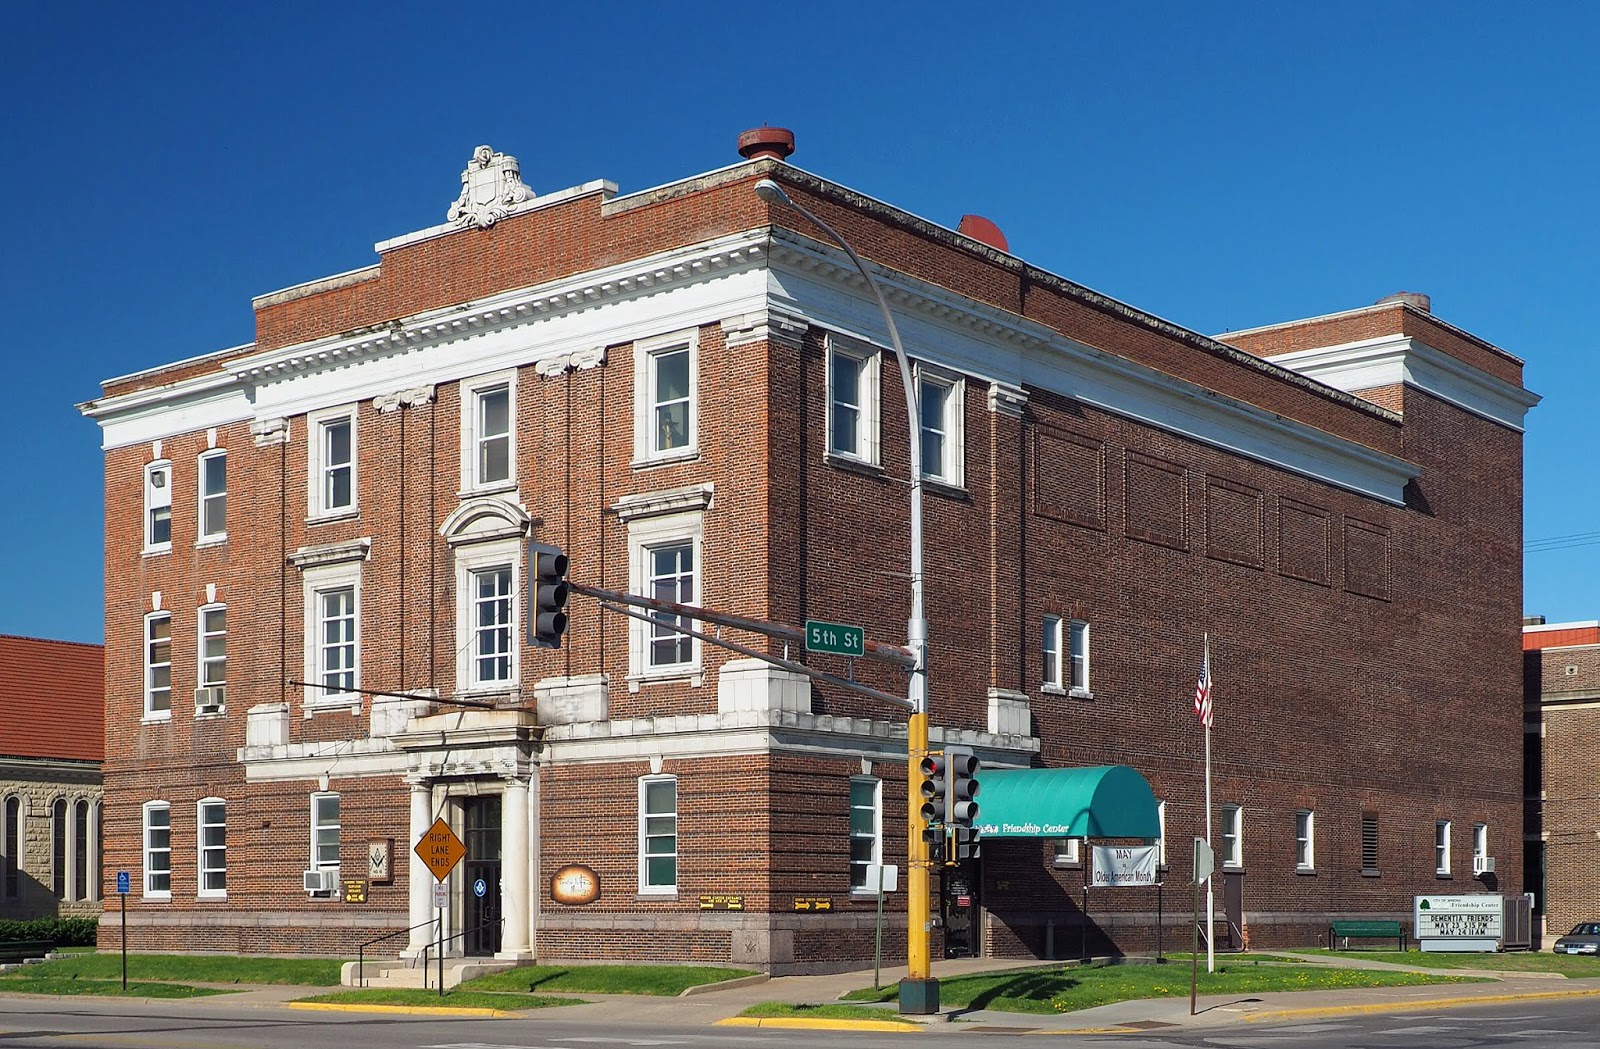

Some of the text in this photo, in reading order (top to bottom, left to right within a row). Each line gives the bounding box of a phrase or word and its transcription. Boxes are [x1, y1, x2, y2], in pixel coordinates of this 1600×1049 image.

[812, 628, 858, 649] 5th St
[1002, 822, 1041, 835] Friendship
[1042, 823, 1070, 833] Center
[429, 833, 451, 843] RIGHT
[431, 846, 449, 855] LANE
[1115, 849, 1132, 859] MAY
[431, 858, 450, 867] ENDS
[1096, 870, 1152, 882] Older American Month
